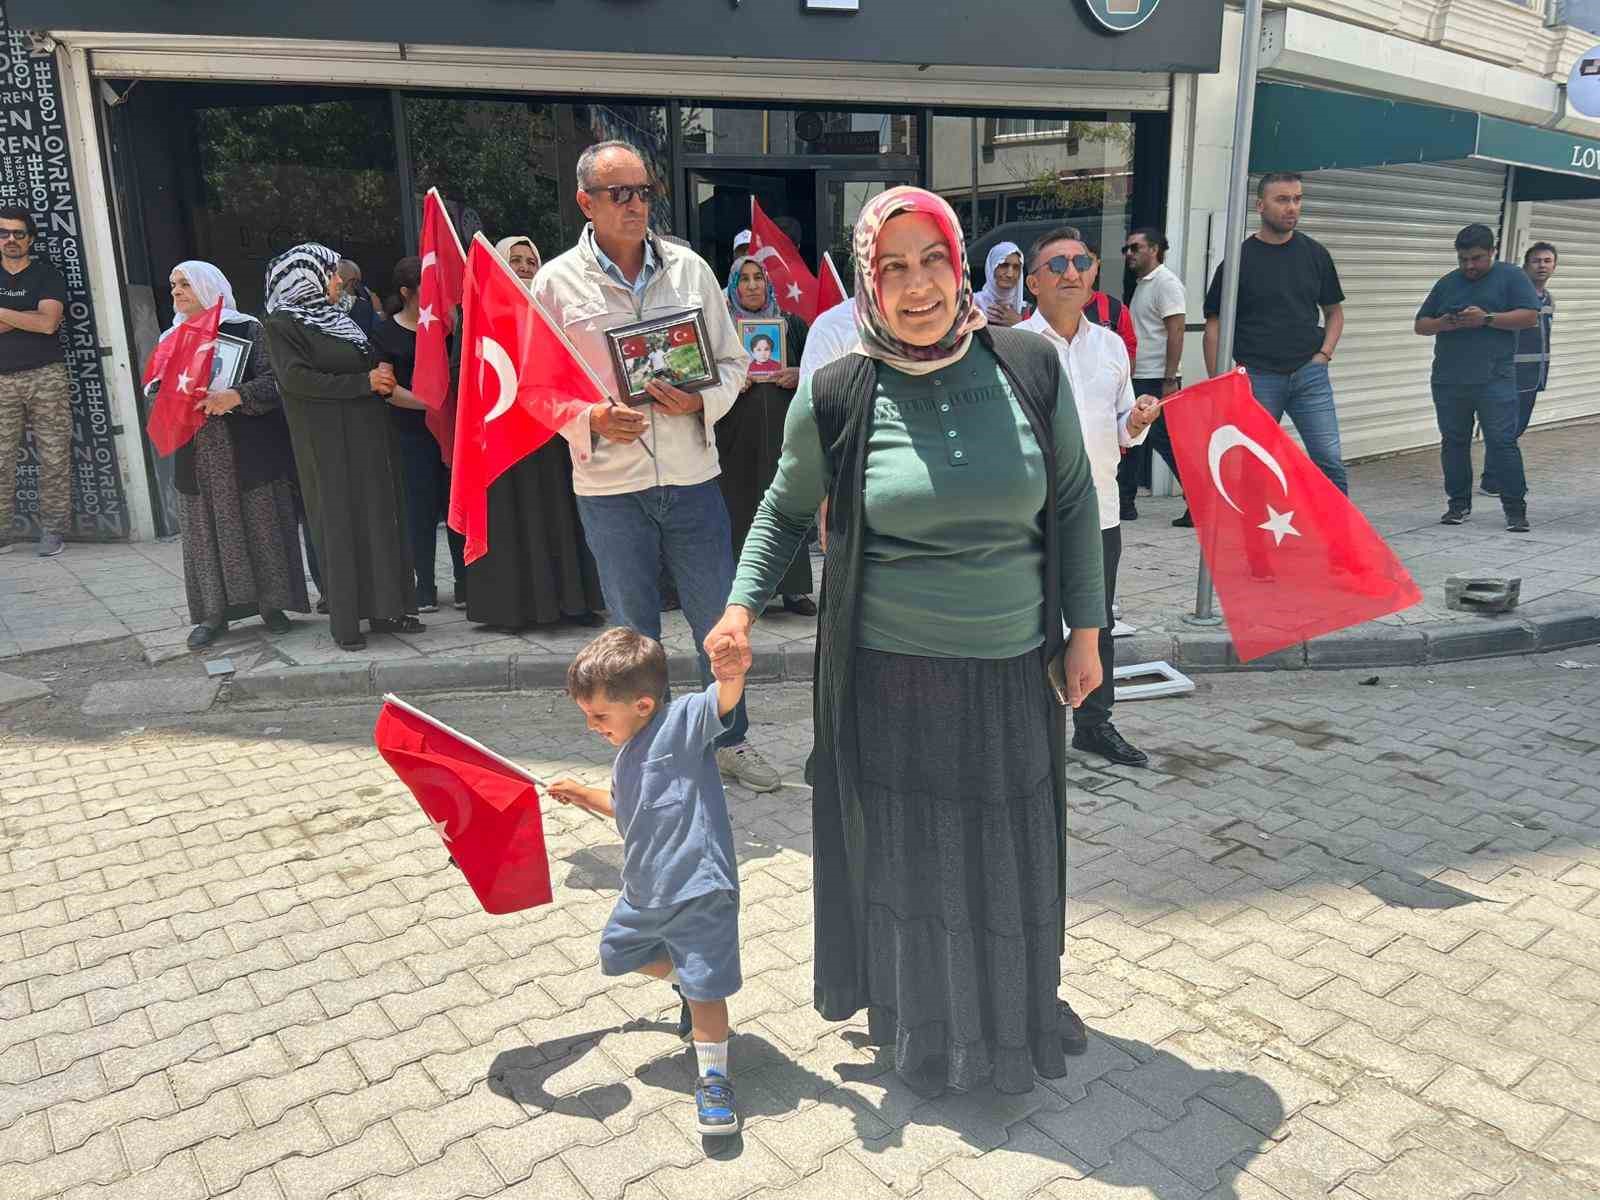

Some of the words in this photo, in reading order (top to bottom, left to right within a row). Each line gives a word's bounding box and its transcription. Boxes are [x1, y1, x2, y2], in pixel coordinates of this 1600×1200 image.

[34, 61, 57, 122] COFFEE
[26, 153, 49, 211] COFFEE
[43, 124, 73, 211] LOVREN
[62, 237, 83, 289] COFFEE
[67, 290, 100, 378] LOVREN
[85, 380, 108, 435] COFFEE
[79, 463, 100, 515] COFFEE
[93, 438, 121, 515] LOVREN
